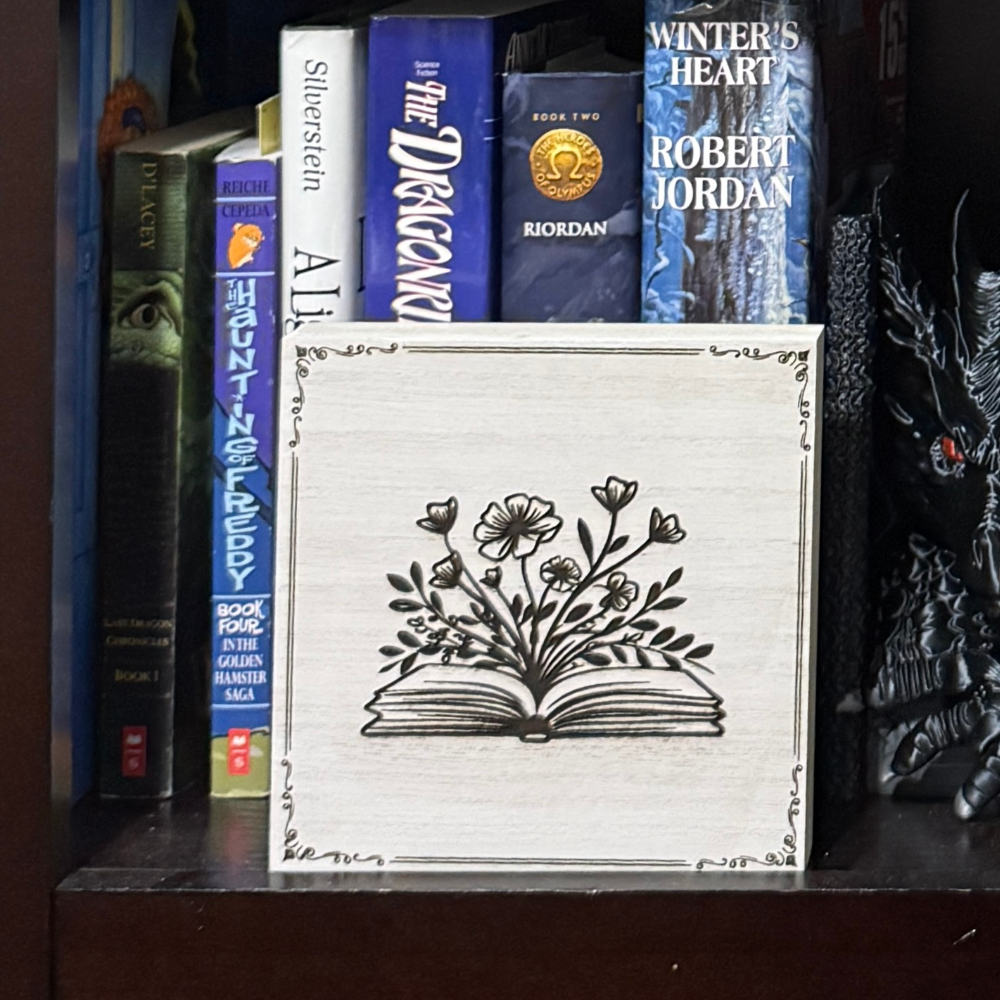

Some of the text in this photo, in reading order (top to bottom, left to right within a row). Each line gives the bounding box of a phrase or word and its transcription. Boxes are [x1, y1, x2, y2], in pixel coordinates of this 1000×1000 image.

[650, 20, 800, 51] WINTER'S
[670, 56, 779, 86] HEART
[404, 80, 447, 129] THE
[303, 59, 329, 192] Silverstein
[533, 112, 600, 122] BOOK TWO
[556, 131, 597, 156] HEROES
[651, 135, 796, 170] ROBERT
[222, 180, 271, 195] REICHE
[536, 171, 596, 198] OF OLYMPUS
[651, 175, 795, 210] JORDAN
[139, 162, 158, 250] D'LACEY
[222, 203, 271, 218] CEPEDA
[523, 220, 608, 238] RIORDAN
[294, 246, 341, 279] A
[228, 454, 256, 465] OF
[224, 465, 260, 592] FREDDY
[217, 600, 266, 620] BOOK
[219, 618, 264, 635] FOUR
[222, 637, 259, 652] IN THE
[218, 654, 264, 669] GOLDEN
[214, 670, 267, 685] HAMSTER
[225, 687, 254, 702] SAGA
